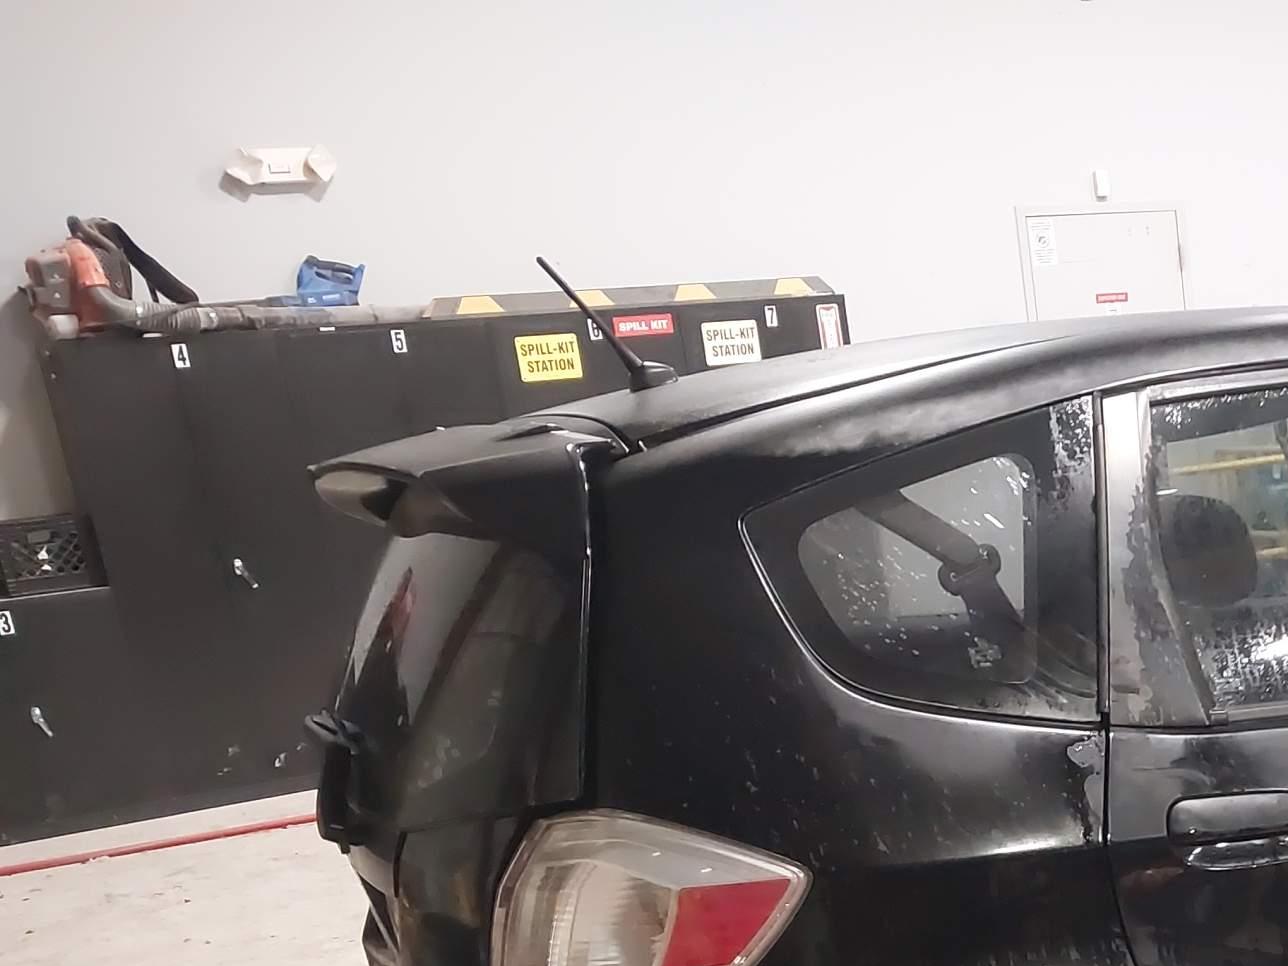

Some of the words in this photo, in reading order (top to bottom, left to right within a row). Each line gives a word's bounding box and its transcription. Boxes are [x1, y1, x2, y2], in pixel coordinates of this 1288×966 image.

[767, 307, 774, 325] 7
[592, 321, 600, 338] 6
[618, 320, 649, 332] SPILL
[650, 319, 669, 330] KIT
[393, 331, 404, 352] 5
[706, 327, 755, 342] SPILL-KIT
[177, 345, 186, 366] 4
[520, 341, 575, 357] SPILL-KIT
[712, 343, 755, 358] STATION
[527, 357, 575, 374] STATION
[0, 612, 11, 633] 3
